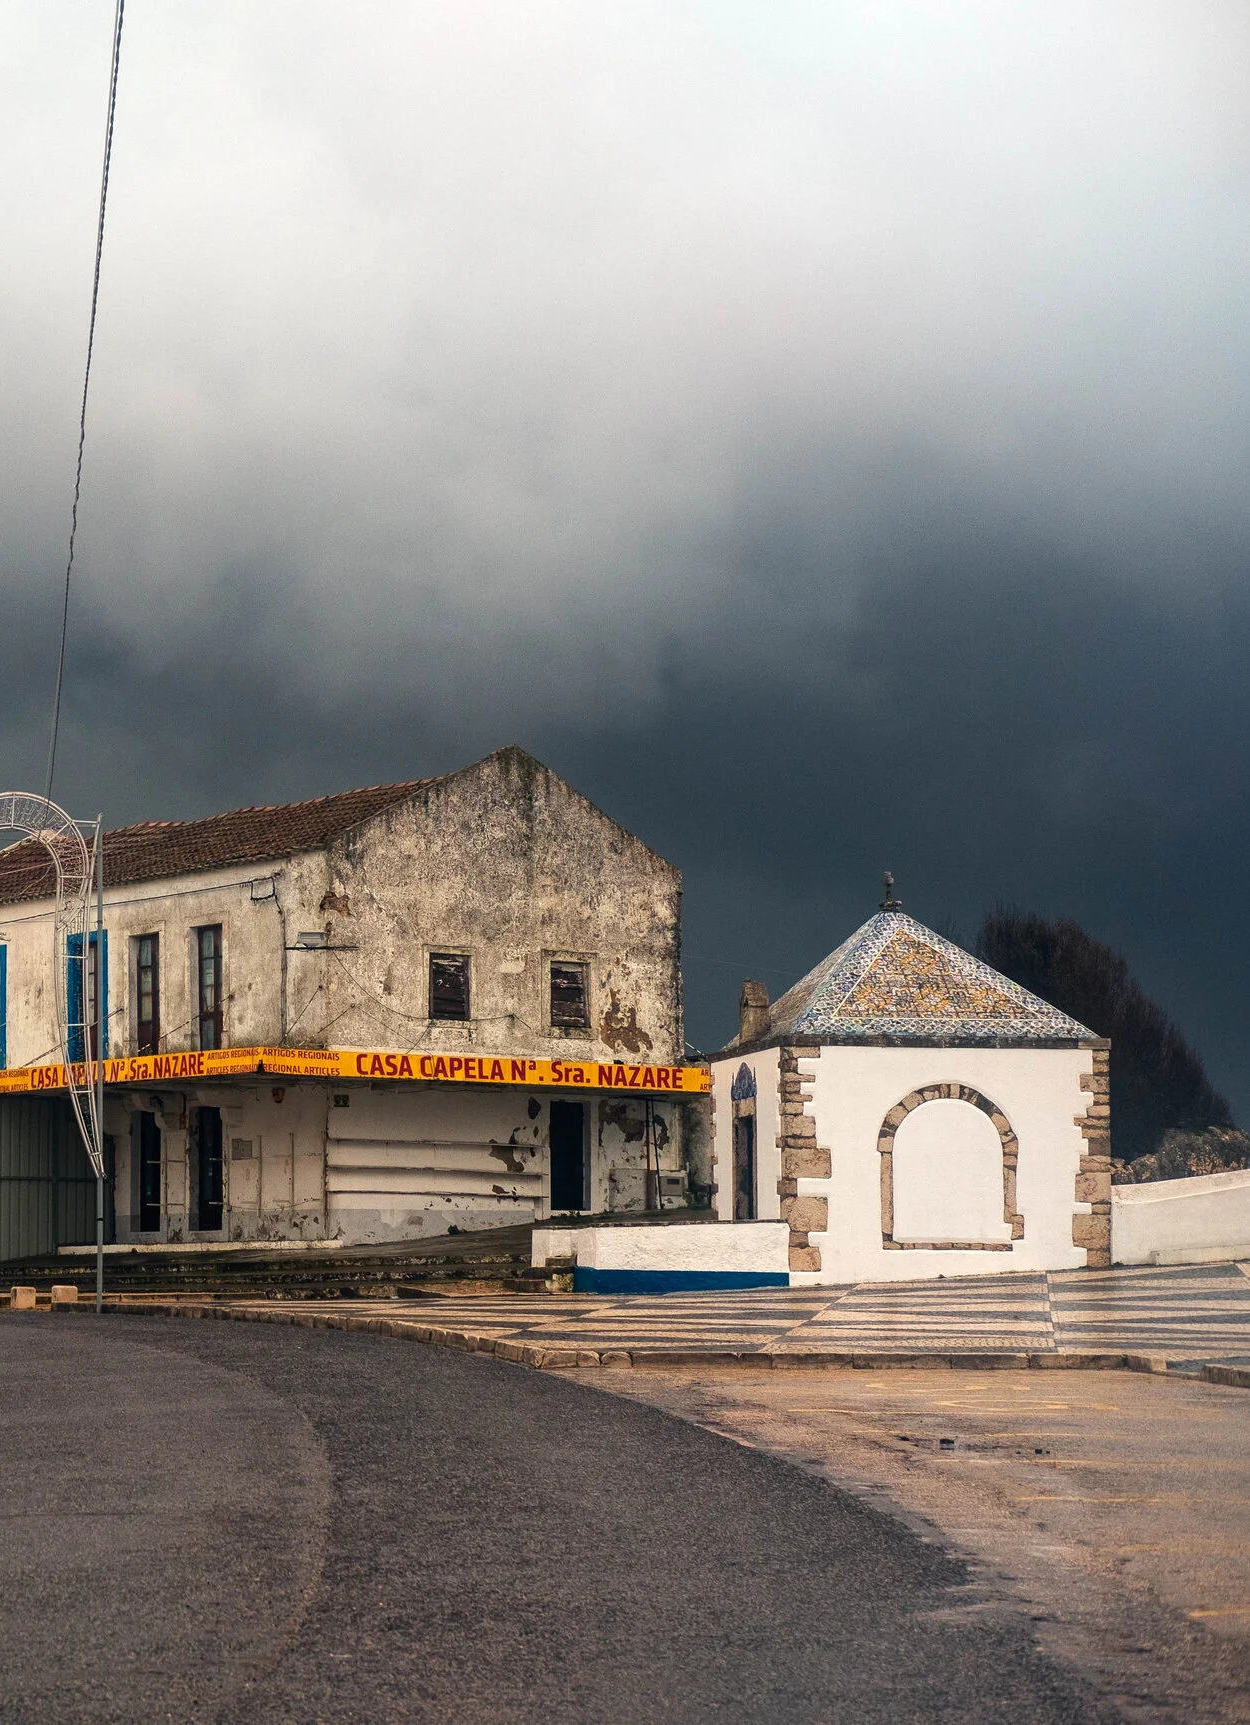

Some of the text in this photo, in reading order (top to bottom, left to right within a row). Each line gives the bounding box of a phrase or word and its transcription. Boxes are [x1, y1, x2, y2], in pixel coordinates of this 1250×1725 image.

[207, 1050, 230, 1060] ARTIGOS
[262, 1049, 340, 1061] ARTIGOS REGIONAIS
[31, 1067, 59, 1089] CASA
[129, 1059, 152, 1080] Sra.
[153, 1050, 204, 1078] NAZARÉ
[206, 1065, 229, 1075] ARTICLES
[262, 1063, 340, 1076] REGIONAL ARTICLES
[355, 1053, 413, 1077] CASA
[420, 1055, 505, 1081] CAPELA
[551, 1060, 591, 1084] Sra.
[597, 1064, 683, 1089] NAZARÉ
